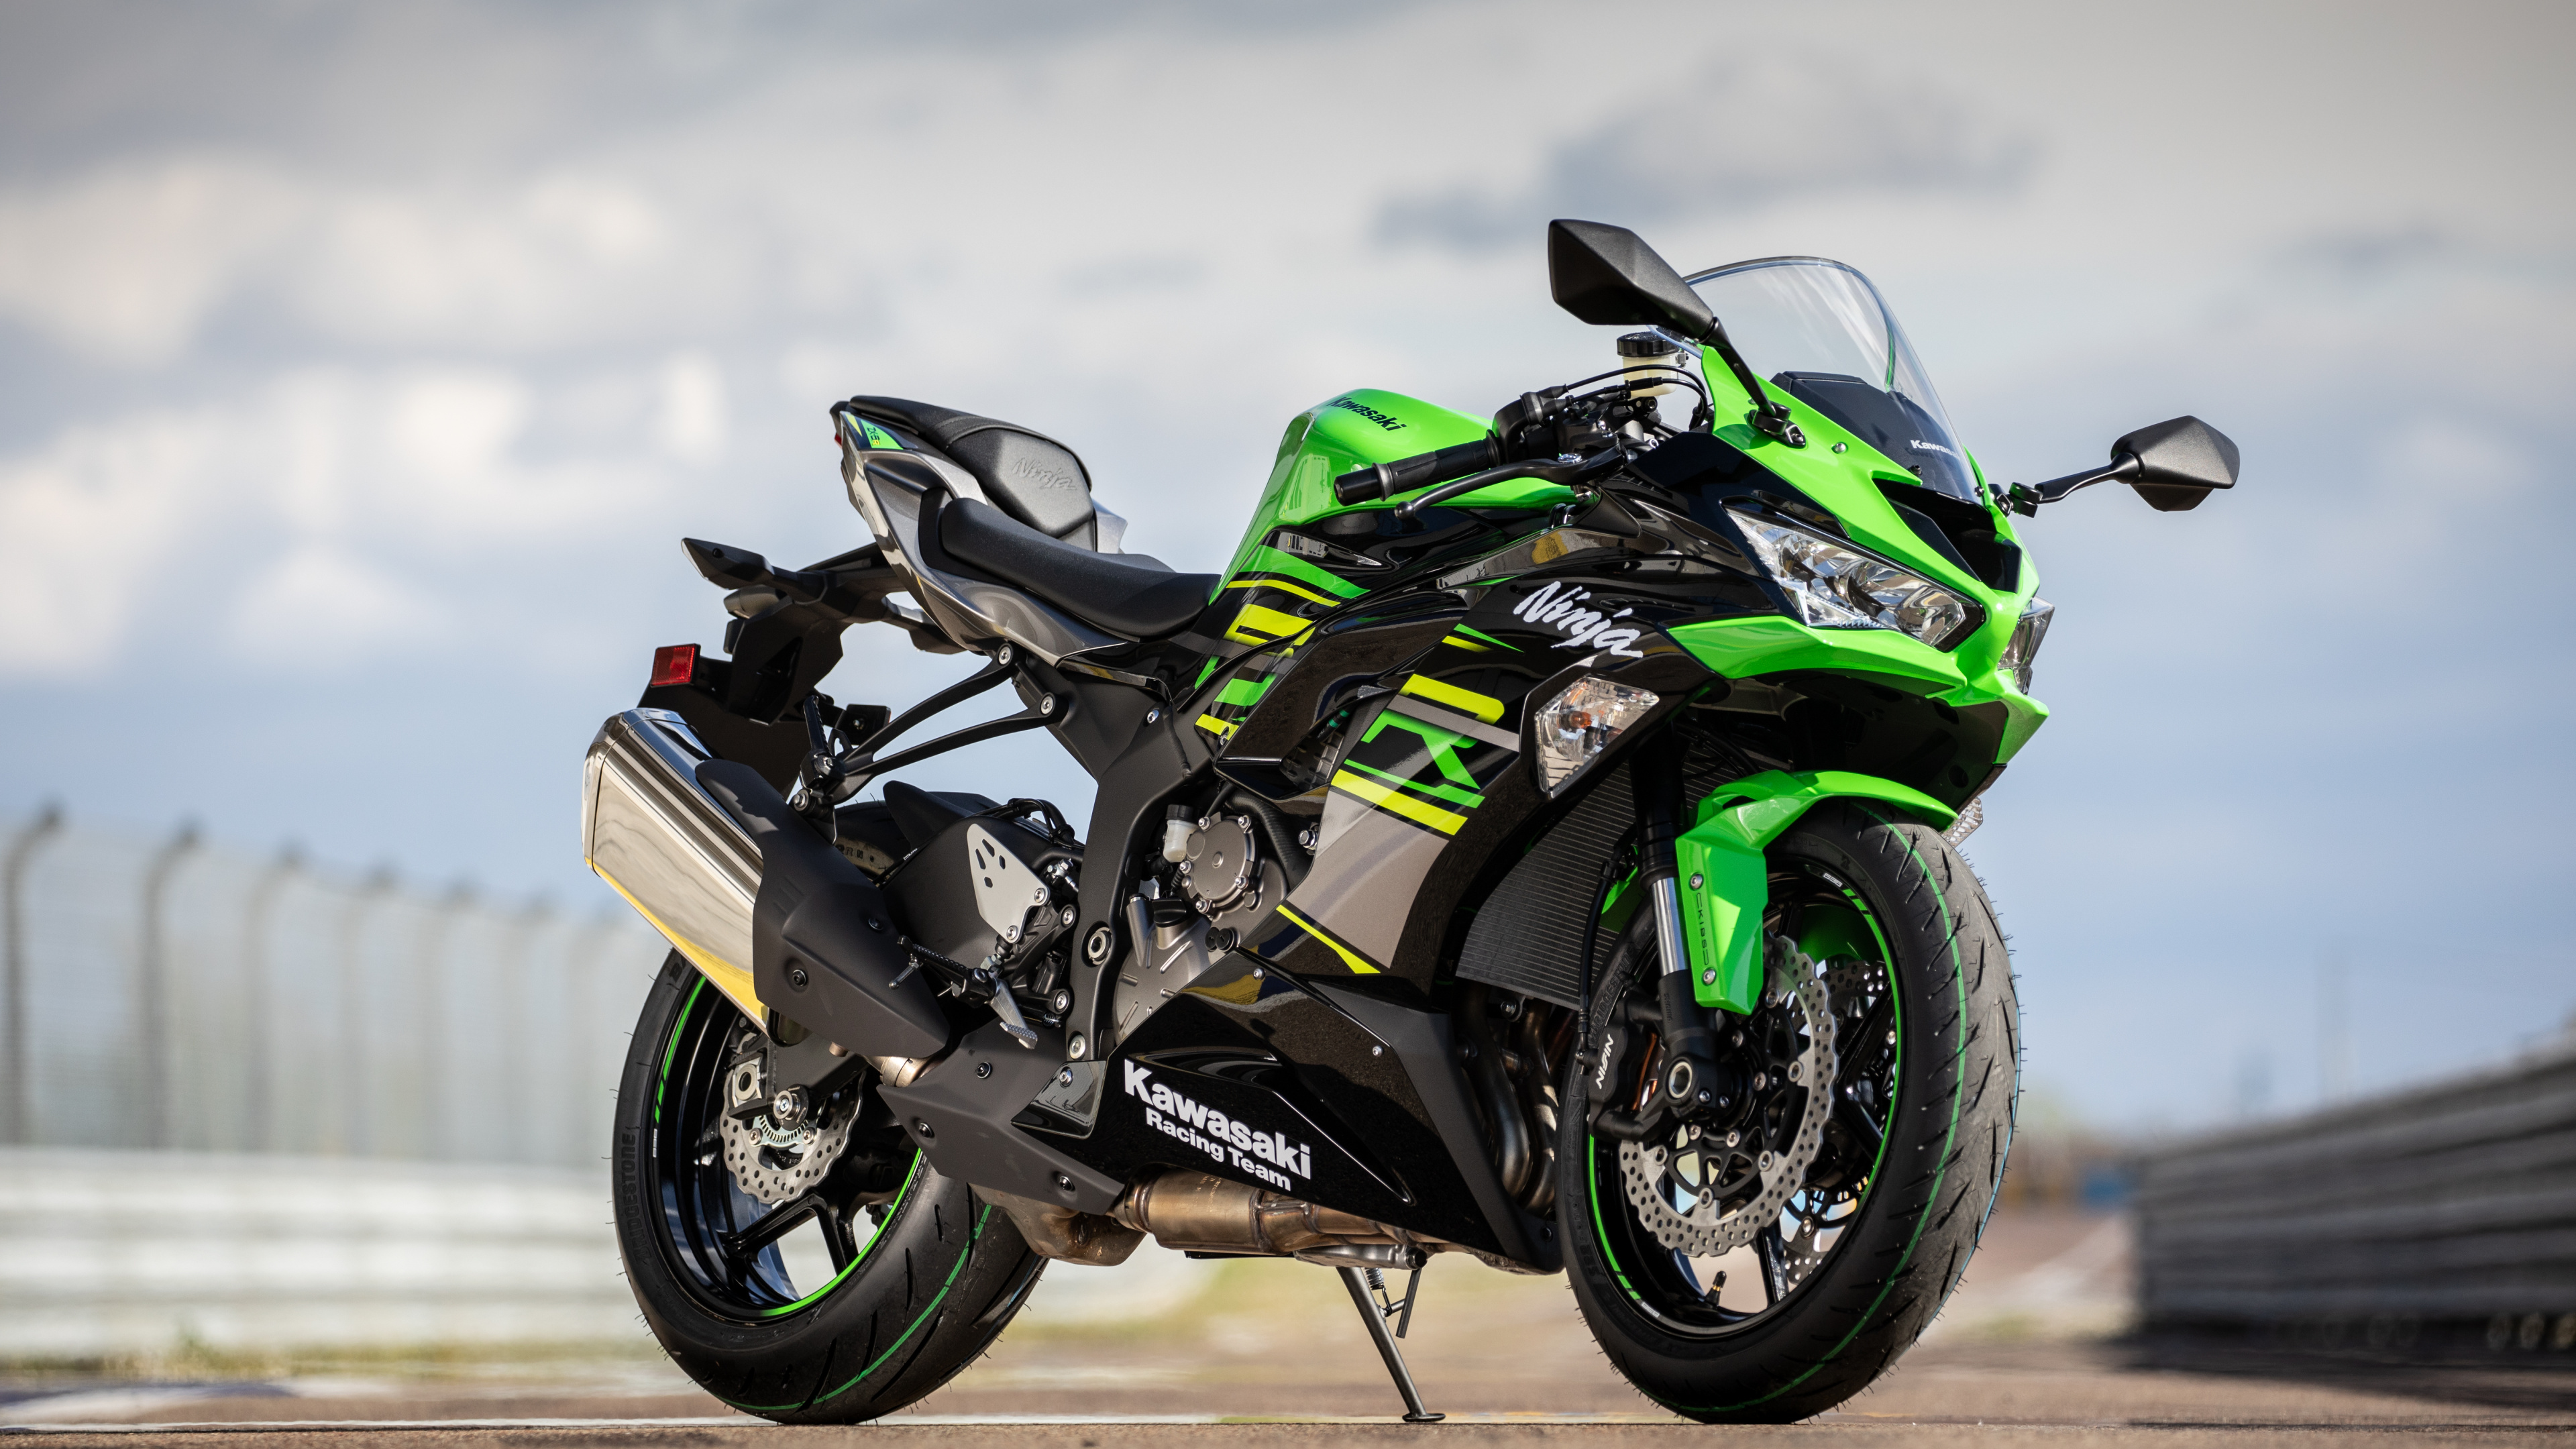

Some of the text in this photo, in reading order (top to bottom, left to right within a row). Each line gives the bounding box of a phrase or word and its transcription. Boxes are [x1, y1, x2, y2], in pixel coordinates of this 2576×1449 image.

[1326, 396, 1407, 431] Kawasaki
[1012, 458, 1077, 490] Ninja
[1910, 439, 1960, 459] Kawasa
[1513, 581, 1643, 658] Ninja
[1823, 873, 1843, 888] 636
[1596, 1034, 1613, 1089] NISSIN
[1124, 1059, 1311, 1179] Kawasaki
[1146, 1107, 1291, 1191] Racing Team
[621, 1132, 651, 1262] BRIDGESTONE
